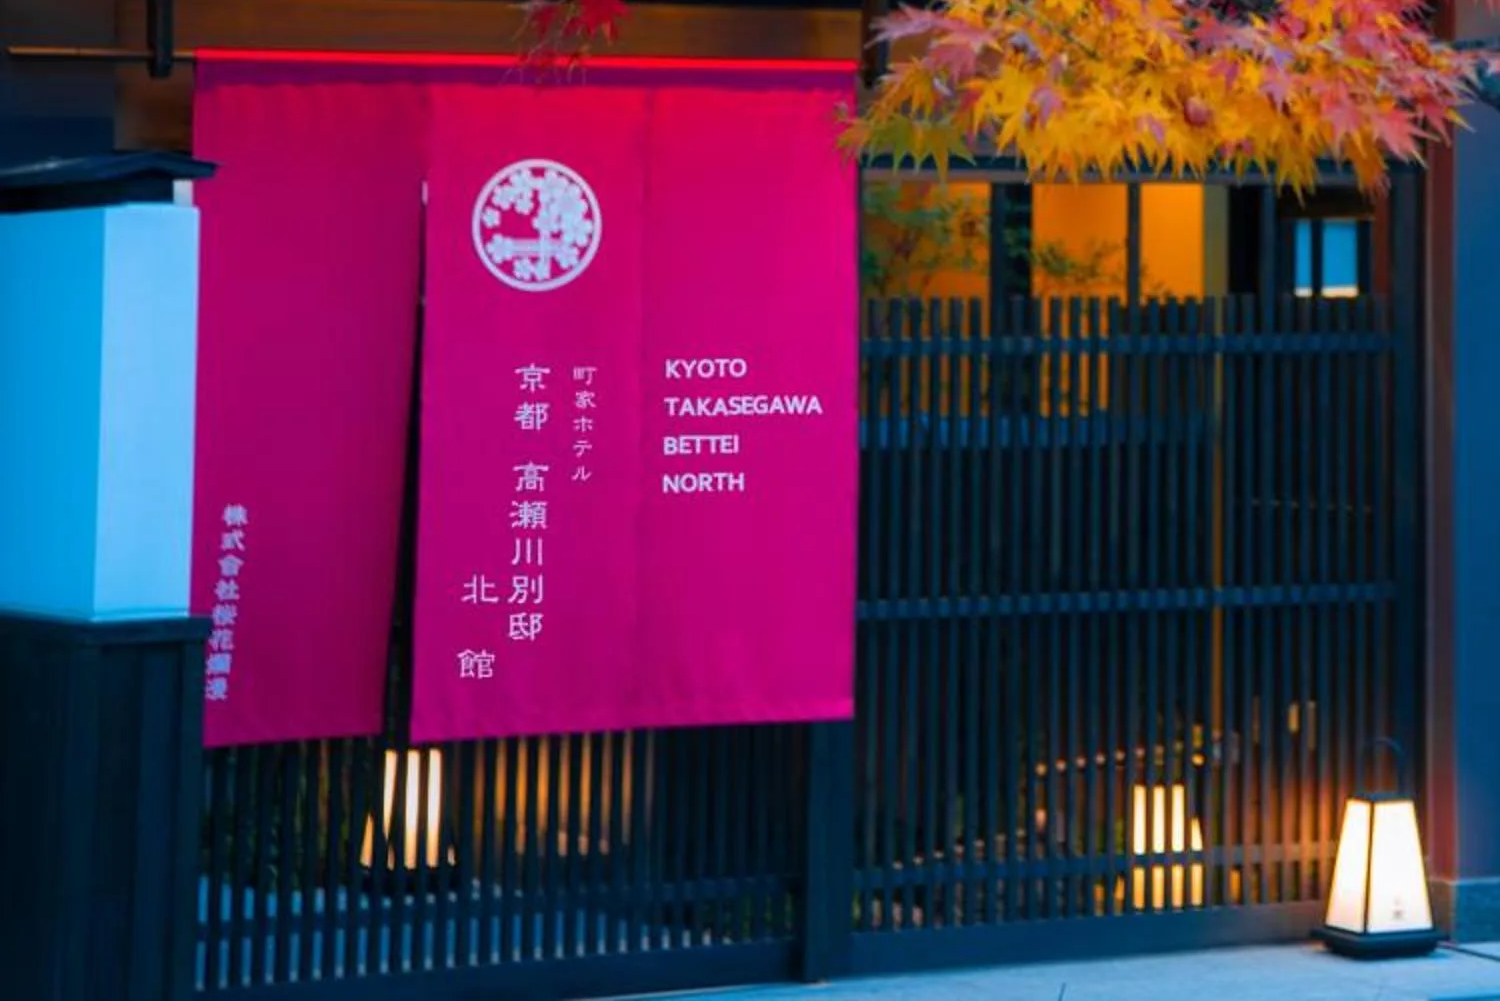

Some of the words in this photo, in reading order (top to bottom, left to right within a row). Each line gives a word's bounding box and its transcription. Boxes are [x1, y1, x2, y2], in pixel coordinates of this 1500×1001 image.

[664, 358, 747, 379] KYOTO
[514, 363, 550, 431] 京都
[664, 395, 823, 417] TAKASEGAWA
[571, 366, 597, 482] 町家ホテル
[663, 435, 739, 455] BETTEI
[662, 473, 745, 493] NORTH
[508, 462, 549, 640] 高瀬川別邸
